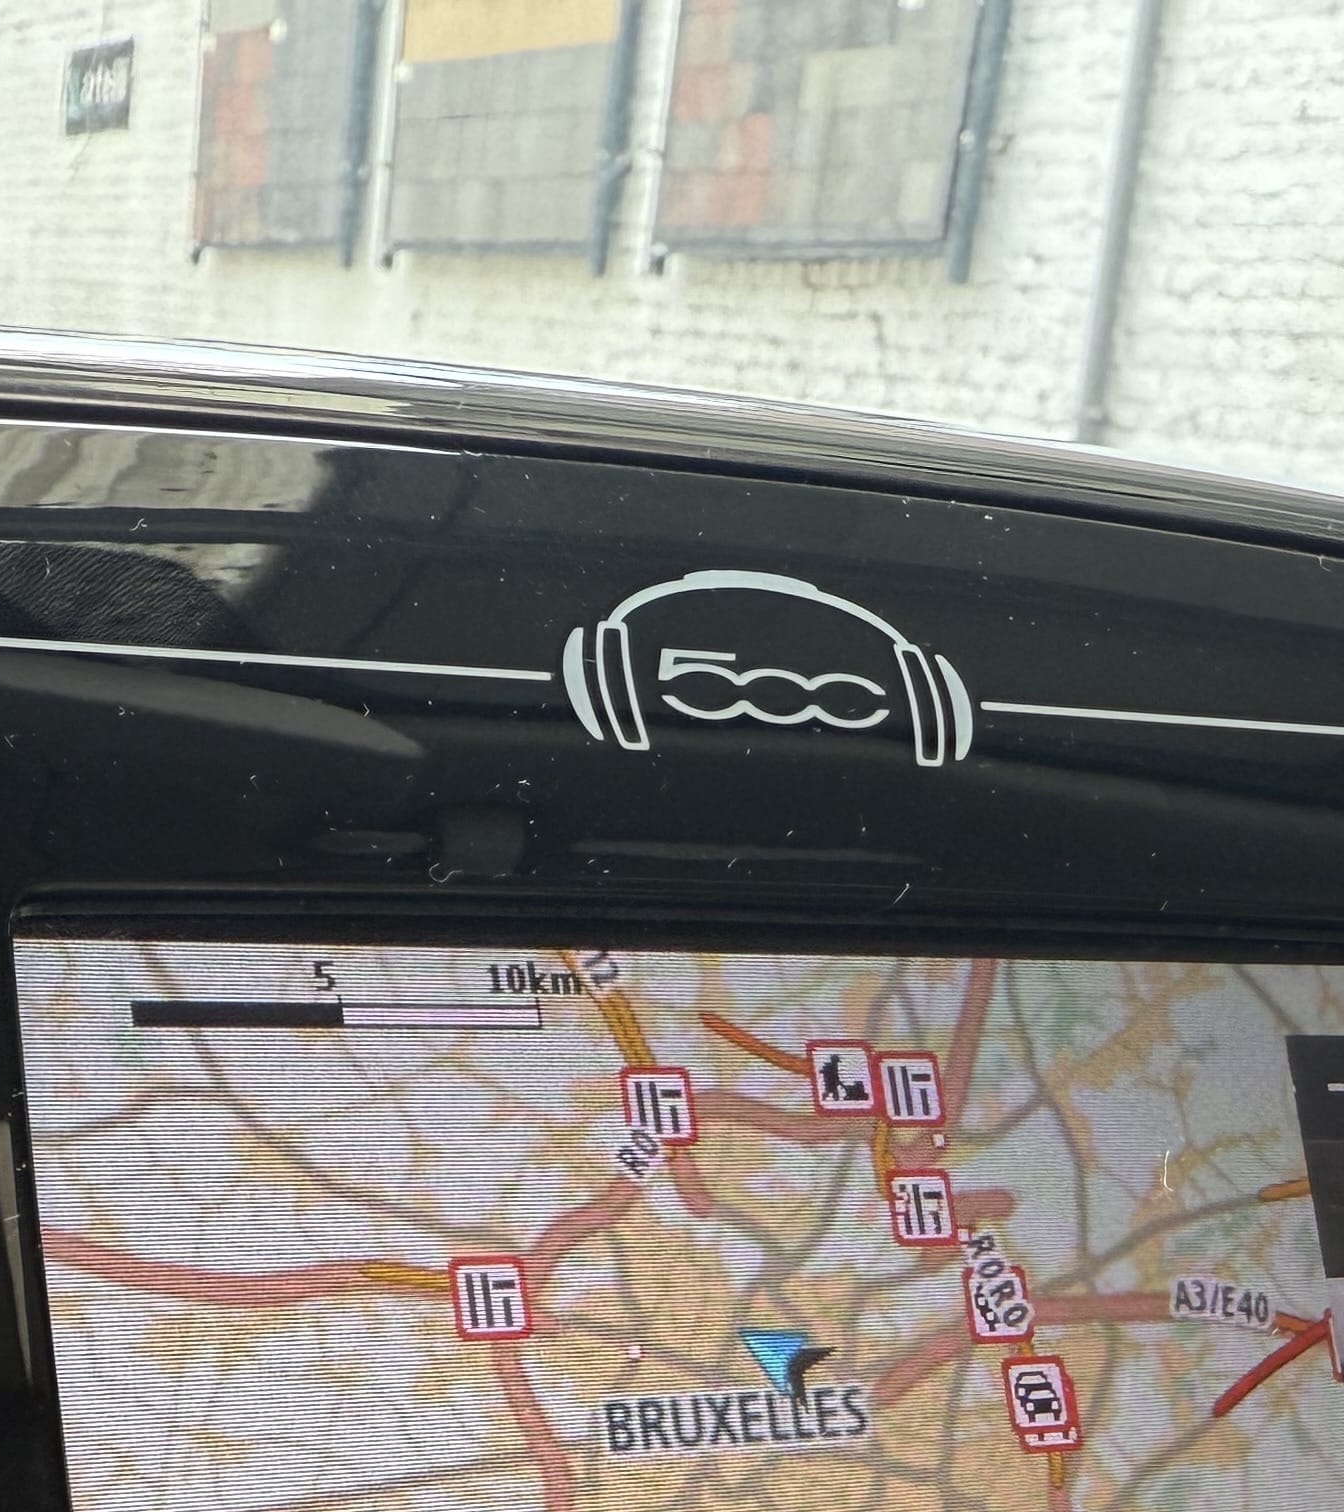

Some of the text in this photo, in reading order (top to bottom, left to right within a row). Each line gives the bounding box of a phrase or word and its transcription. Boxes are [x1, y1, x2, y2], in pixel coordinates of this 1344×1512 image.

[658, 647, 890, 729] 500
[312, 960, 337, 992] 5
[487, 961, 581, 996] 10km
[1174, 1280, 1269, 1323] A3/E40
[607, 1385, 869, 1451] BRUXELLES
